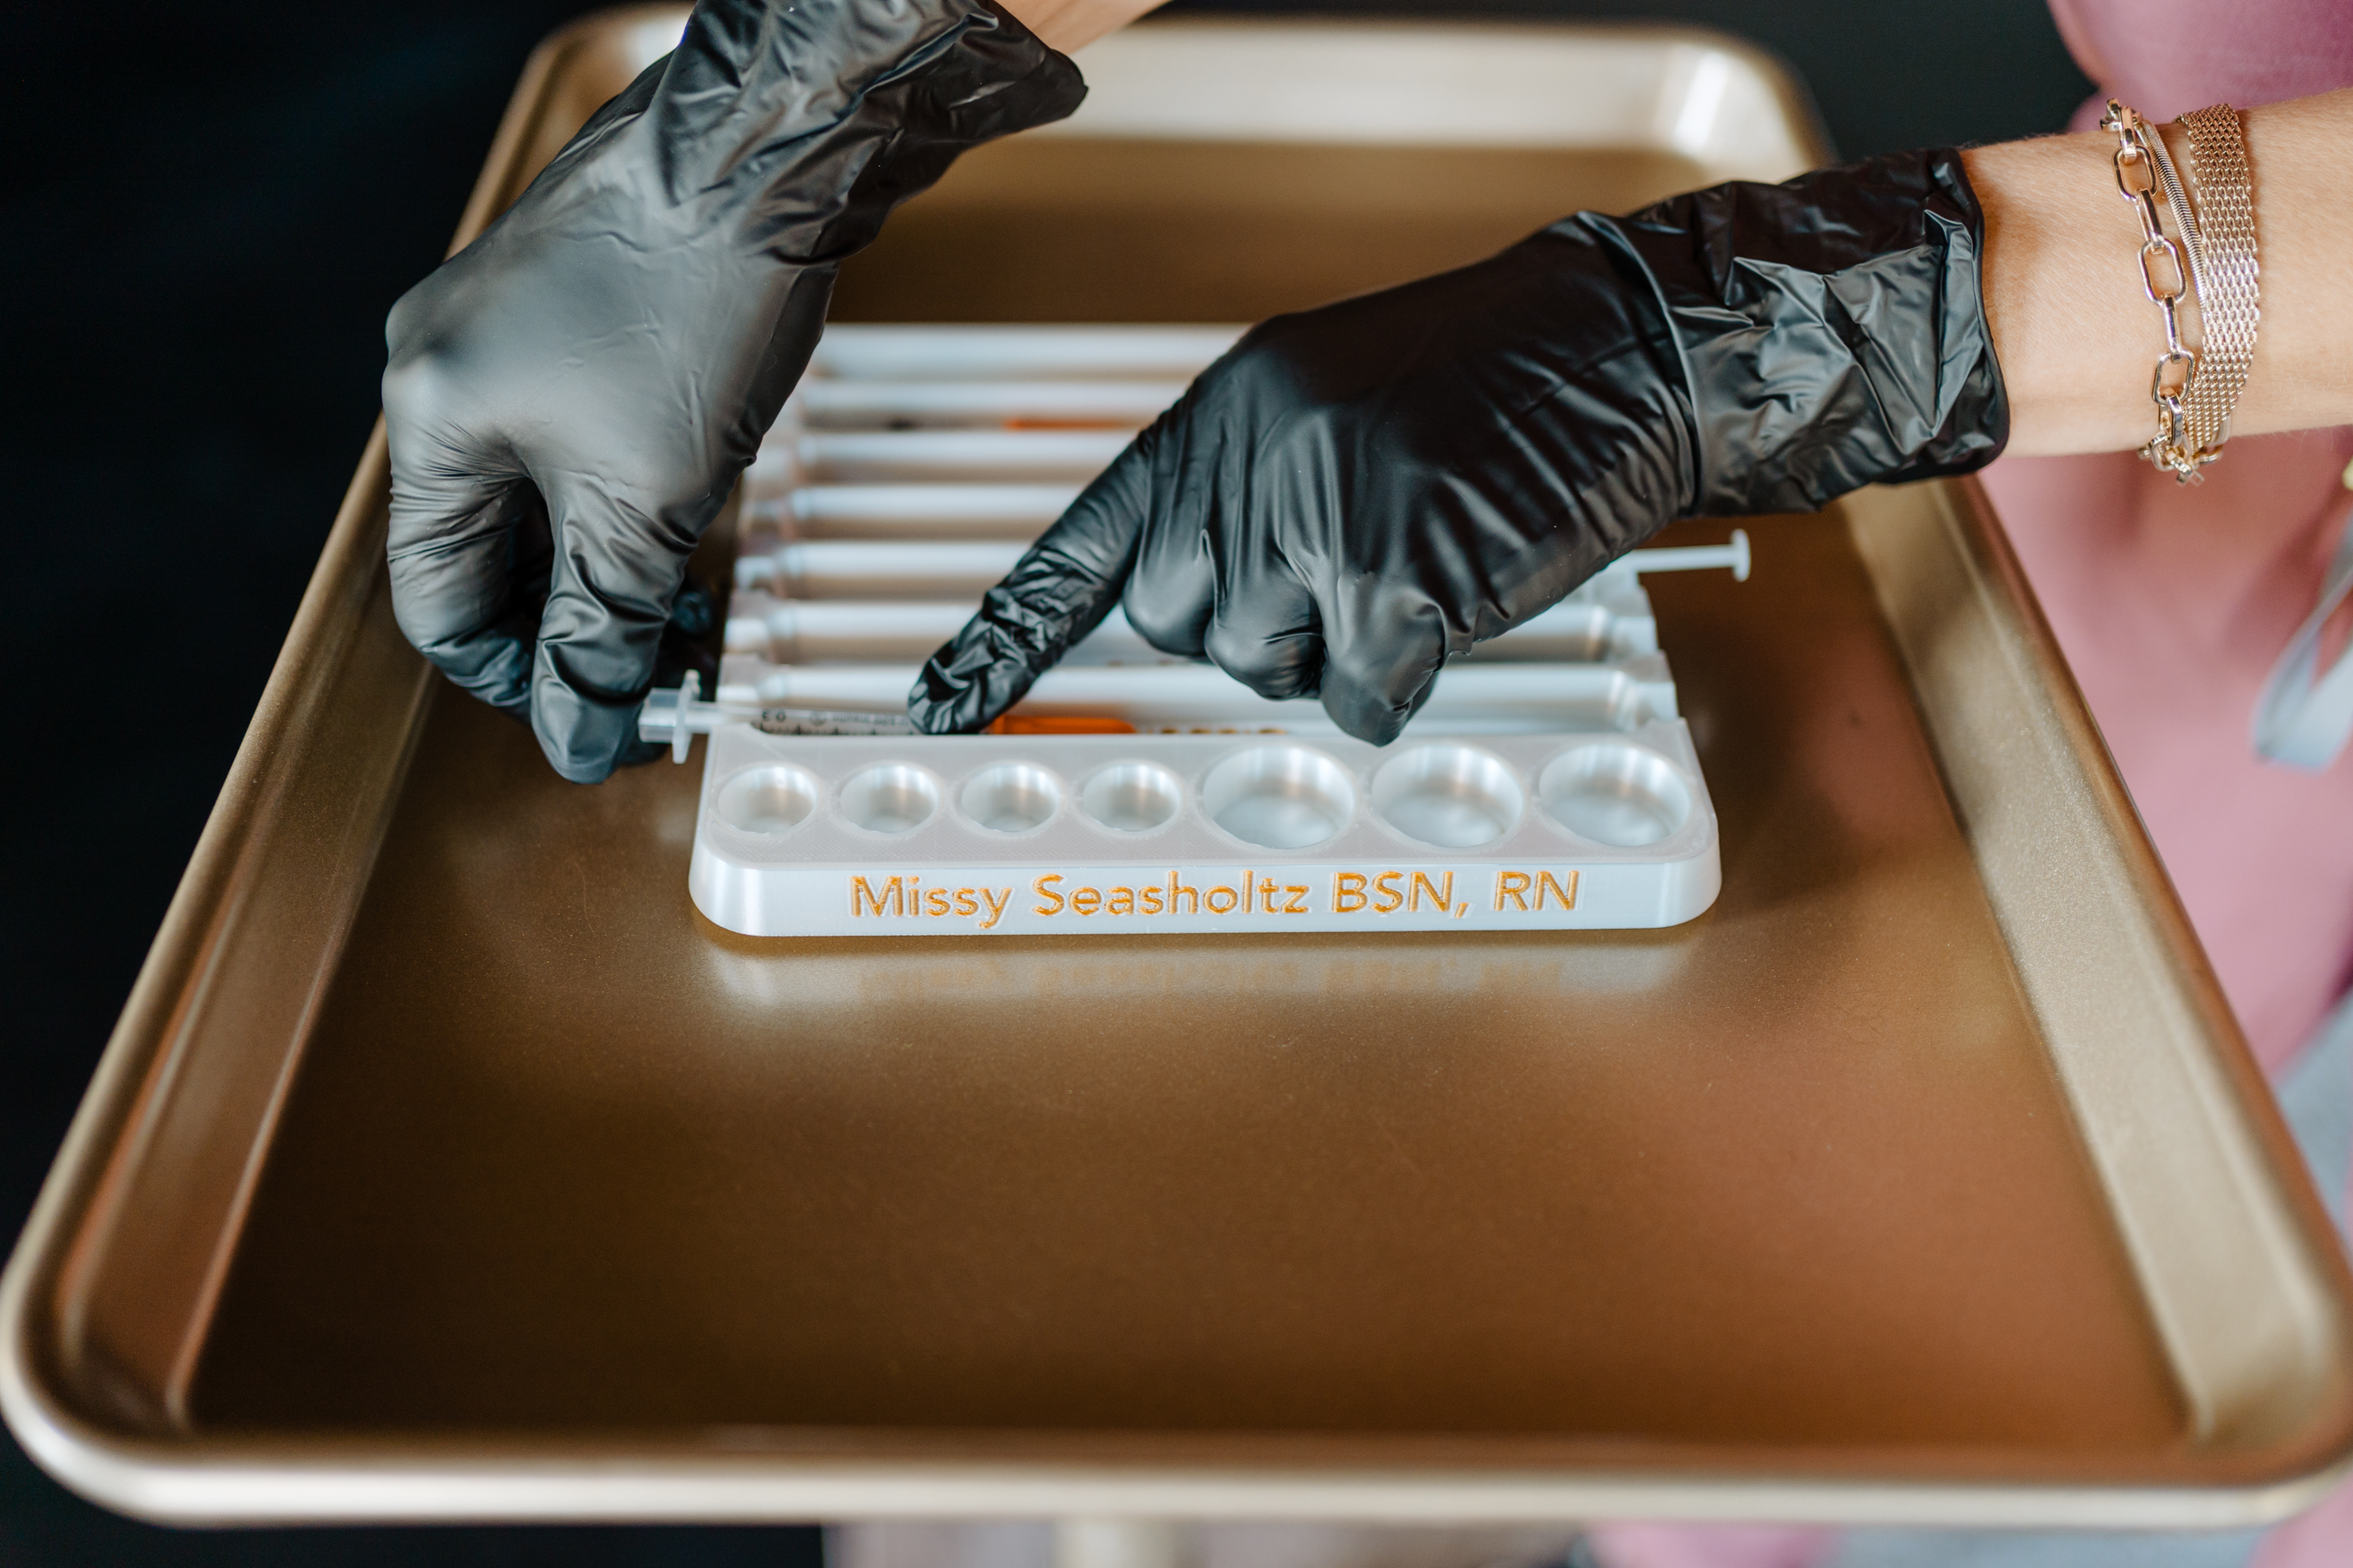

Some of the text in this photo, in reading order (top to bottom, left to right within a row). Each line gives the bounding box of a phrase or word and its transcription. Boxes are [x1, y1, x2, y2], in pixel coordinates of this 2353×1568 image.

[850, 869, 1580, 930] Missy Seasholtz BSN, RN
